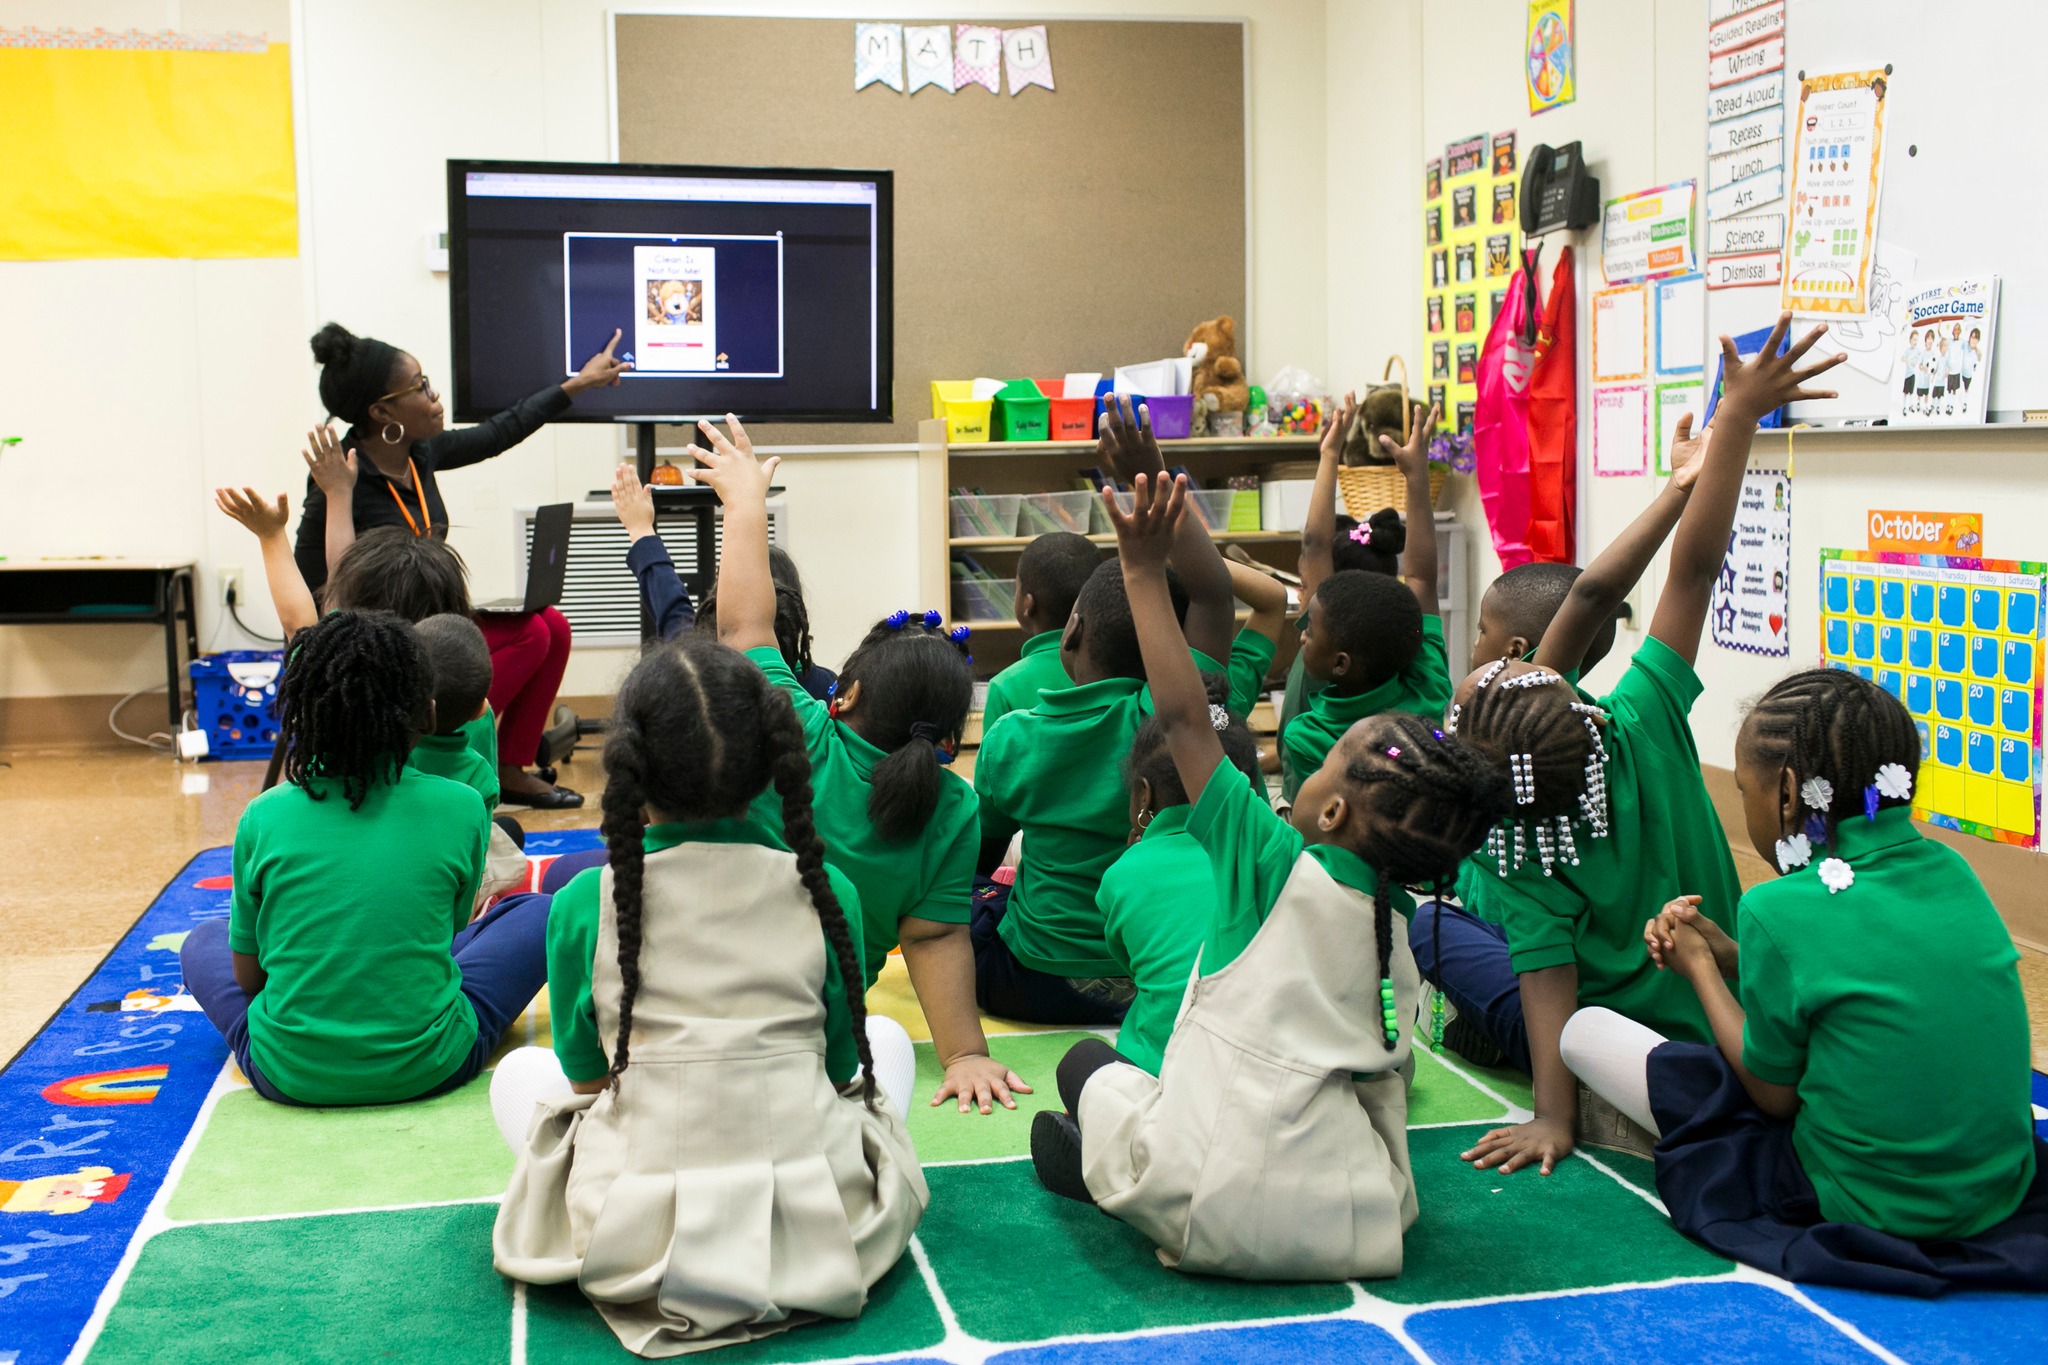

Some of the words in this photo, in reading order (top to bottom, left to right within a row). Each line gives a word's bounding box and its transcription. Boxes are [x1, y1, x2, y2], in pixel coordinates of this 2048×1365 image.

[1713, 25, 1743, 47] Guided
[1745, 11, 1780, 33] Reading
[1728, 49, 1765, 74] Writing
[1715, 94, 1742, 116] Read
[1745, 83, 1775, 107] Aloud
[1728, 124, 1762, 147] Recess
[1731, 158, 1763, 183] Lunch
[1734, 190, 1753, 208] Art
[1726, 230, 1765, 249] Science
[1722, 263, 1766, 283] Dismissal
[1908, 295, 1919, 307] MY
[1921, 288, 1942, 301] FIRST
[1913, 302, 1949, 320] Soccer
[1951, 300, 1984, 314] Game
[1745, 486, 1753, 496] Sit
[1754, 486, 1762, 498] up
[1742, 500, 1765, 511] straight
[1739, 523, 1755, 535] Track
[1756, 524, 1766, 535] the
[1870, 512, 1944, 542] October
[1740, 538, 1764, 548] speaker
[1746, 562, 1757, 572] Ask
[1829, 561, 1847, 571] Sunday
[1855, 562, 1875, 574] Monday
[1883, 565, 1905, 577] Tuesday
[1908, 567, 1937, 579] Wednesday
[1941, 570, 1968, 582] Thursday
[1978, 572, 1997, 584] Friday
[2008, 575, 2037, 588] Saturday
[1722, 568, 1730, 590] A
[1741, 587, 1767, 597] questions
[1854, 579, 1860, 591] 2
[1882, 582, 1888, 594] 3
[1912, 584, 1918, 596] 4
[1941, 587, 1947, 599] 5
[1974, 589, 1980, 603] 6
[2010, 593, 2016, 605] 7
[1722, 609, 1731, 629] R
[1740, 608, 1763, 620] Respect
[1742, 621, 1761, 633] Always
[1828, 620, 1833, 632] 8
[1854, 622, 1860, 635] 9
[1881, 626, 1891, 639] 10
[1910, 629, 1917, 642] 11
[1940, 633, 1950, 646] 12
[1973, 637, 1982, 650] 13
[2006, 642, 2015, 655] 14
[1880, 671, 1888, 683] 17
[1909, 676, 1917, 688] 18
[1938, 680, 1946, 692] 19
[1969, 685, 1984, 698] 20
[2003, 691, 2013, 703] 21
[1938, 725, 1949, 739] 26
[1970, 733, 1981, 746] 27
[2002, 740, 2014, 753] 28
